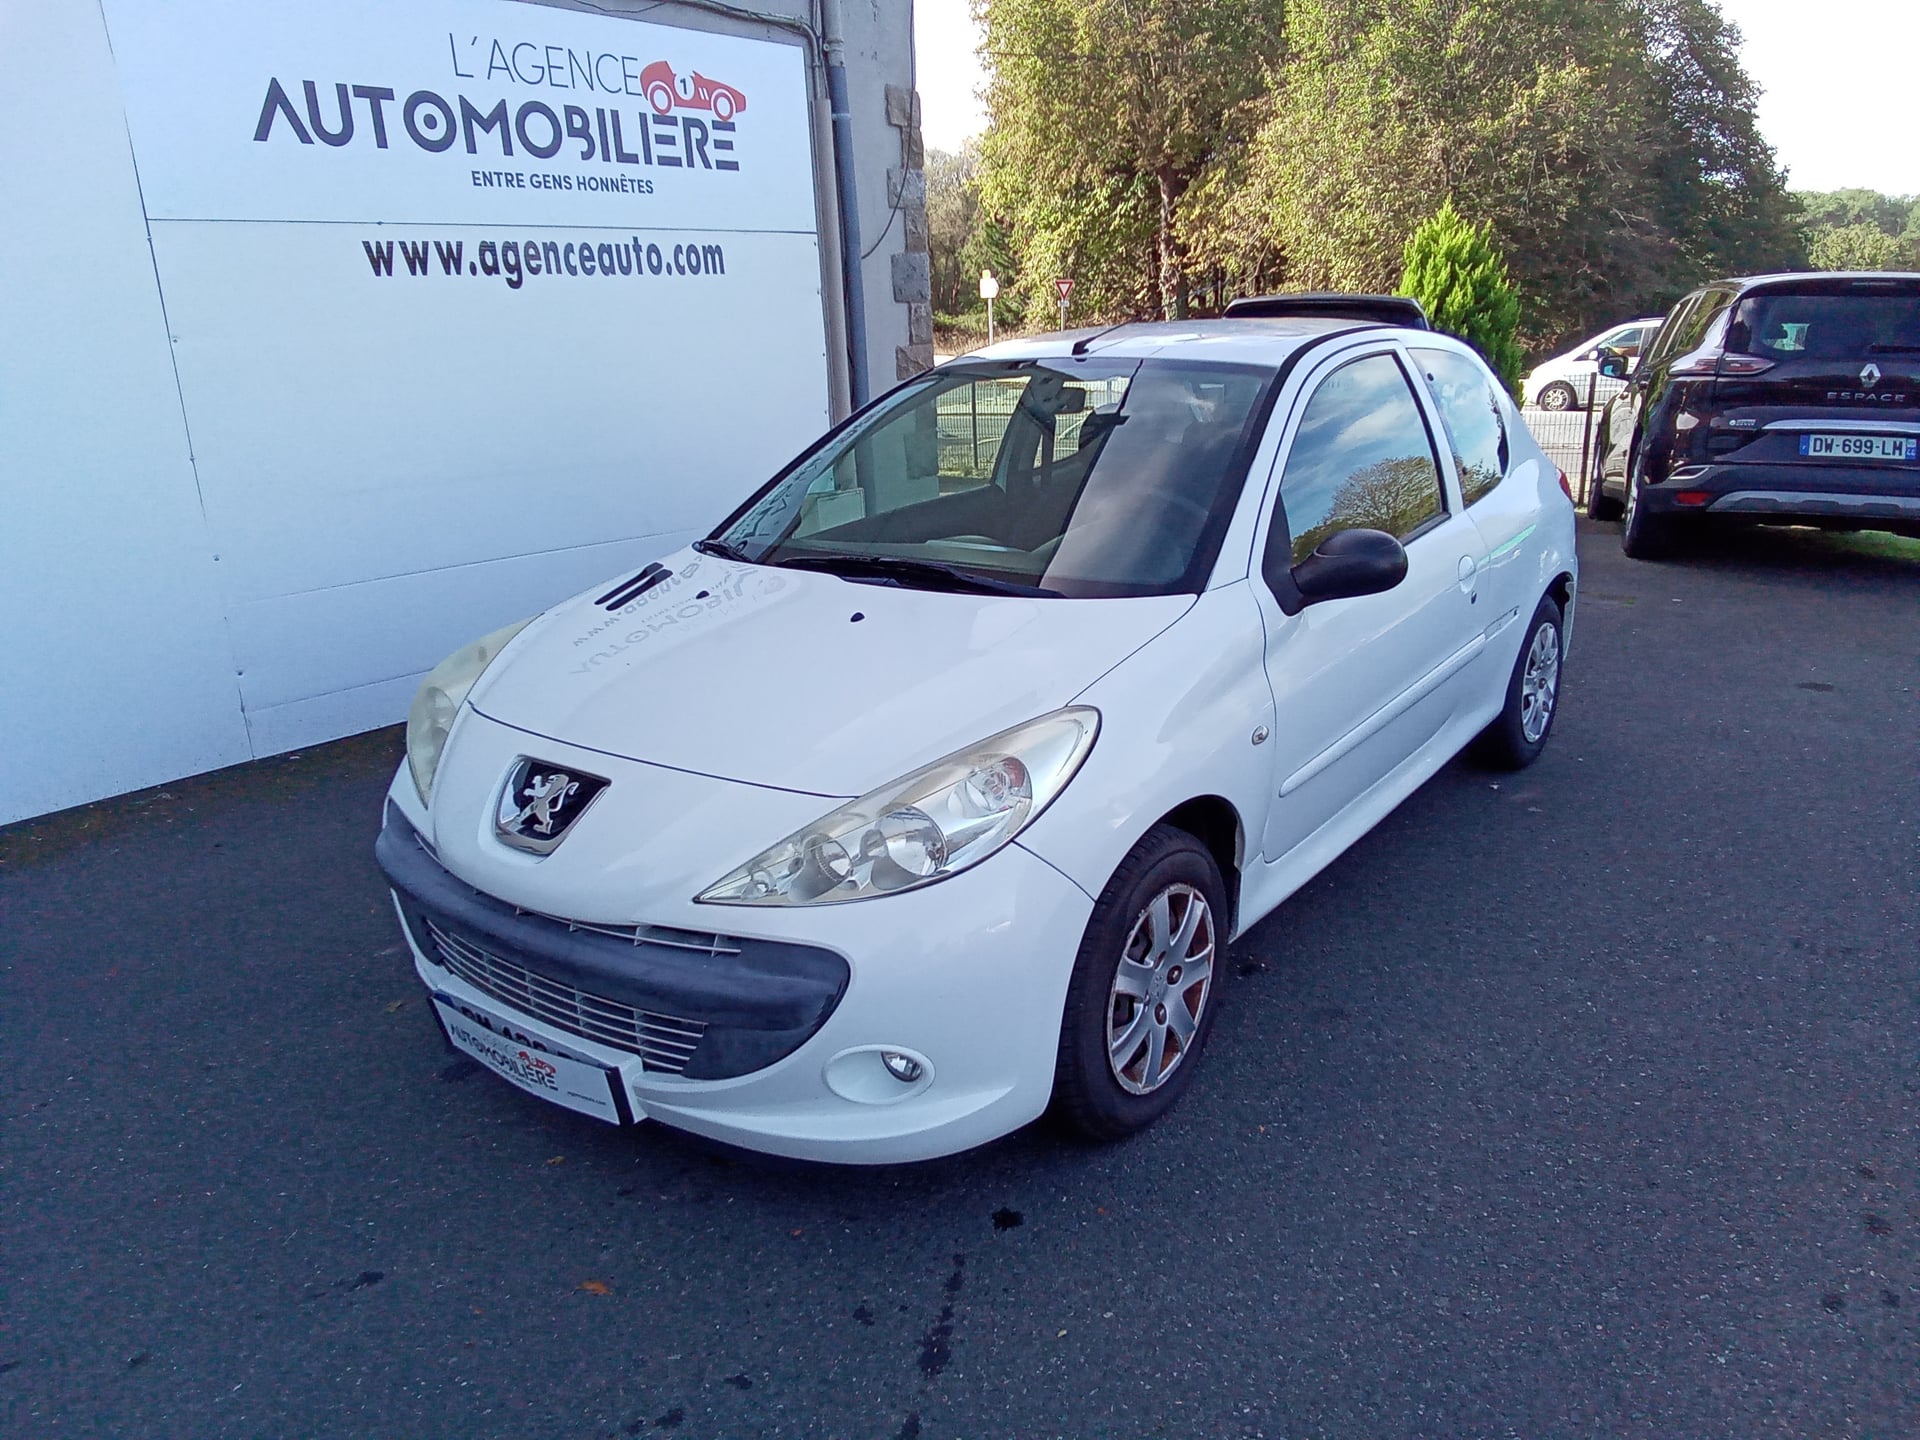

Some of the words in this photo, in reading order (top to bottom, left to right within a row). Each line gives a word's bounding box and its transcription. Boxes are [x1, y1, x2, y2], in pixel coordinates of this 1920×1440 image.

[448, 32, 643, 98] L'AGENCE
[680, 78, 688, 95] 1
[253, 77, 740, 172] AUTOMOBILIERE
[471, 170, 526, 190] ENTRE
[529, 173, 573, 192] GENS
[576, 173, 654, 195] HONNÊTES
[362, 236, 726, 289] www.agenceauto.com
[1826, 391, 1906, 402] ESPACE
